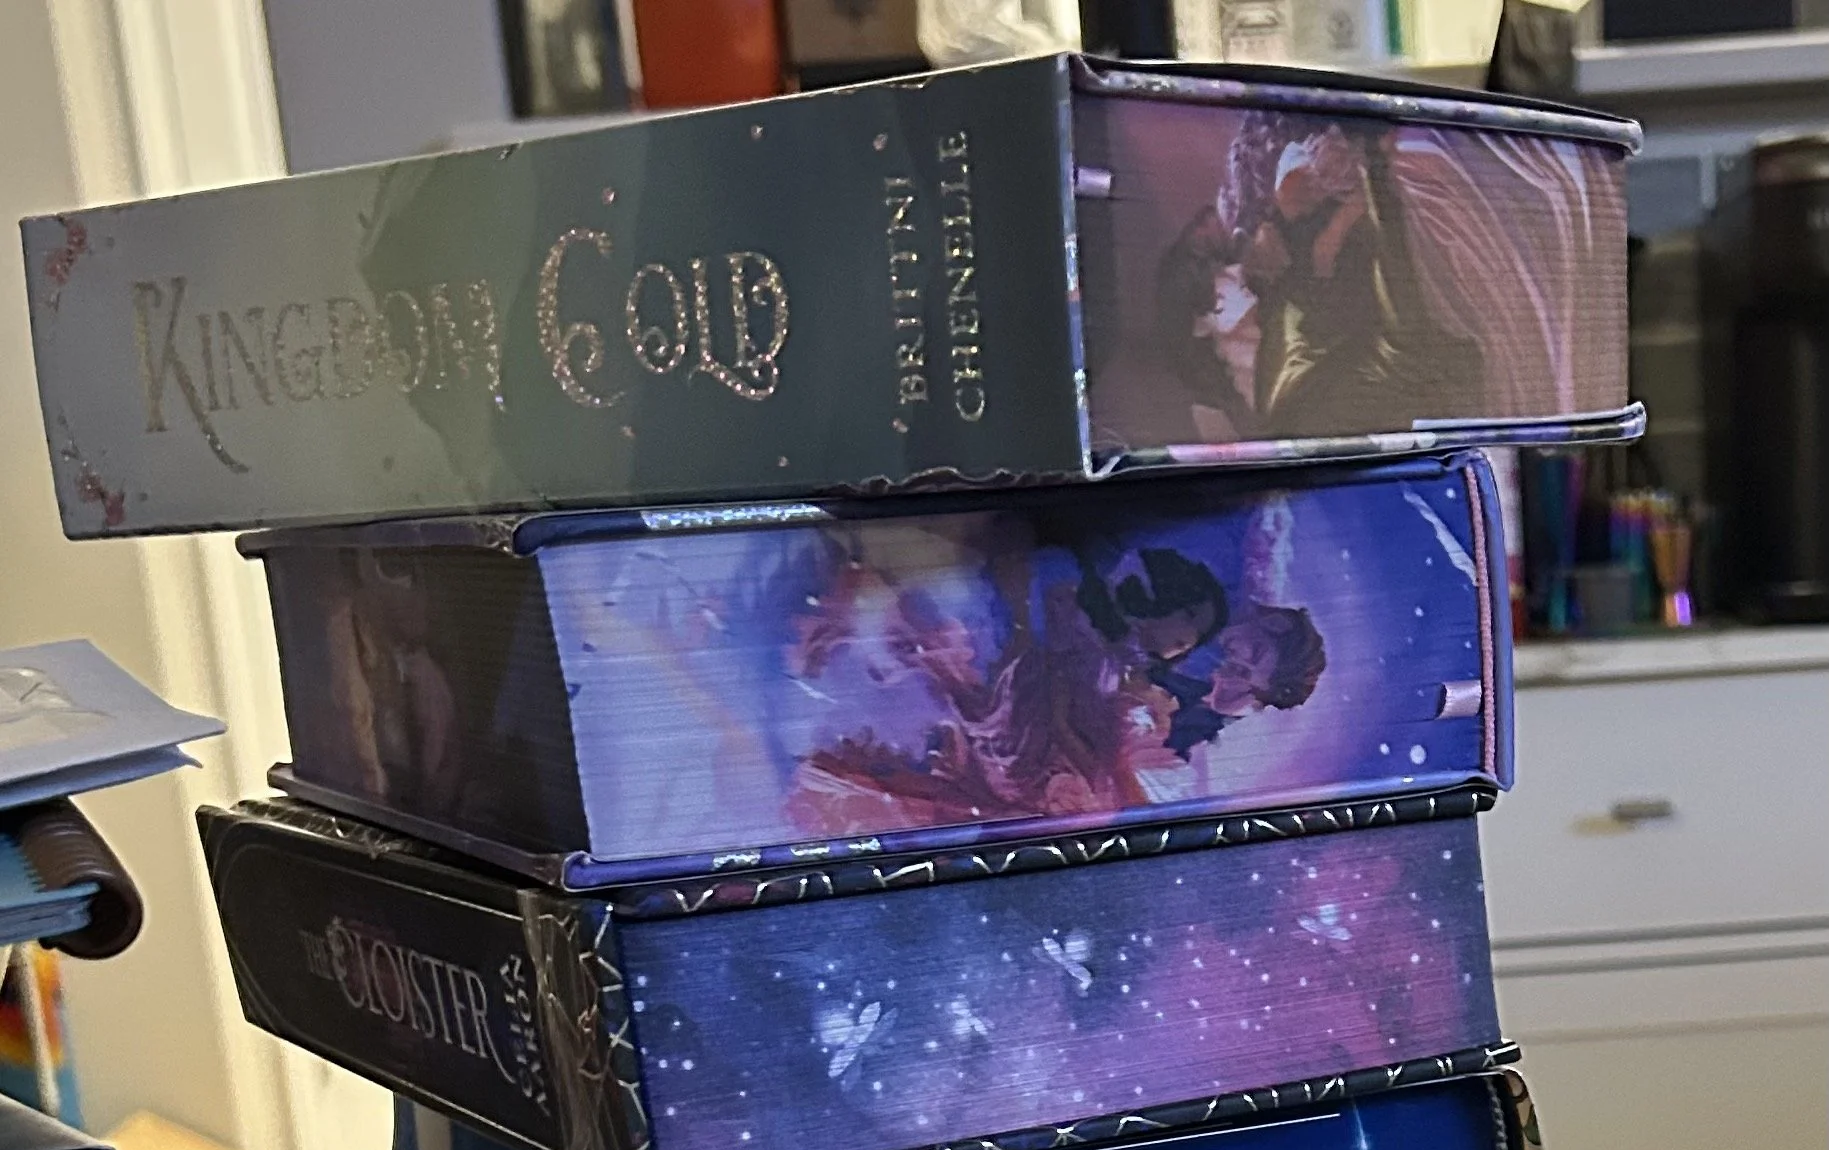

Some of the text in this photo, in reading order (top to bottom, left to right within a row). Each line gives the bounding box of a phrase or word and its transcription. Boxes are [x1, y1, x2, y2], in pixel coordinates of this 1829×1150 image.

[132, 227, 790, 474] KINGDOM COLD
[883, 177, 929, 406] BRITTNI
[938, 130, 986, 422] CHENELLE
